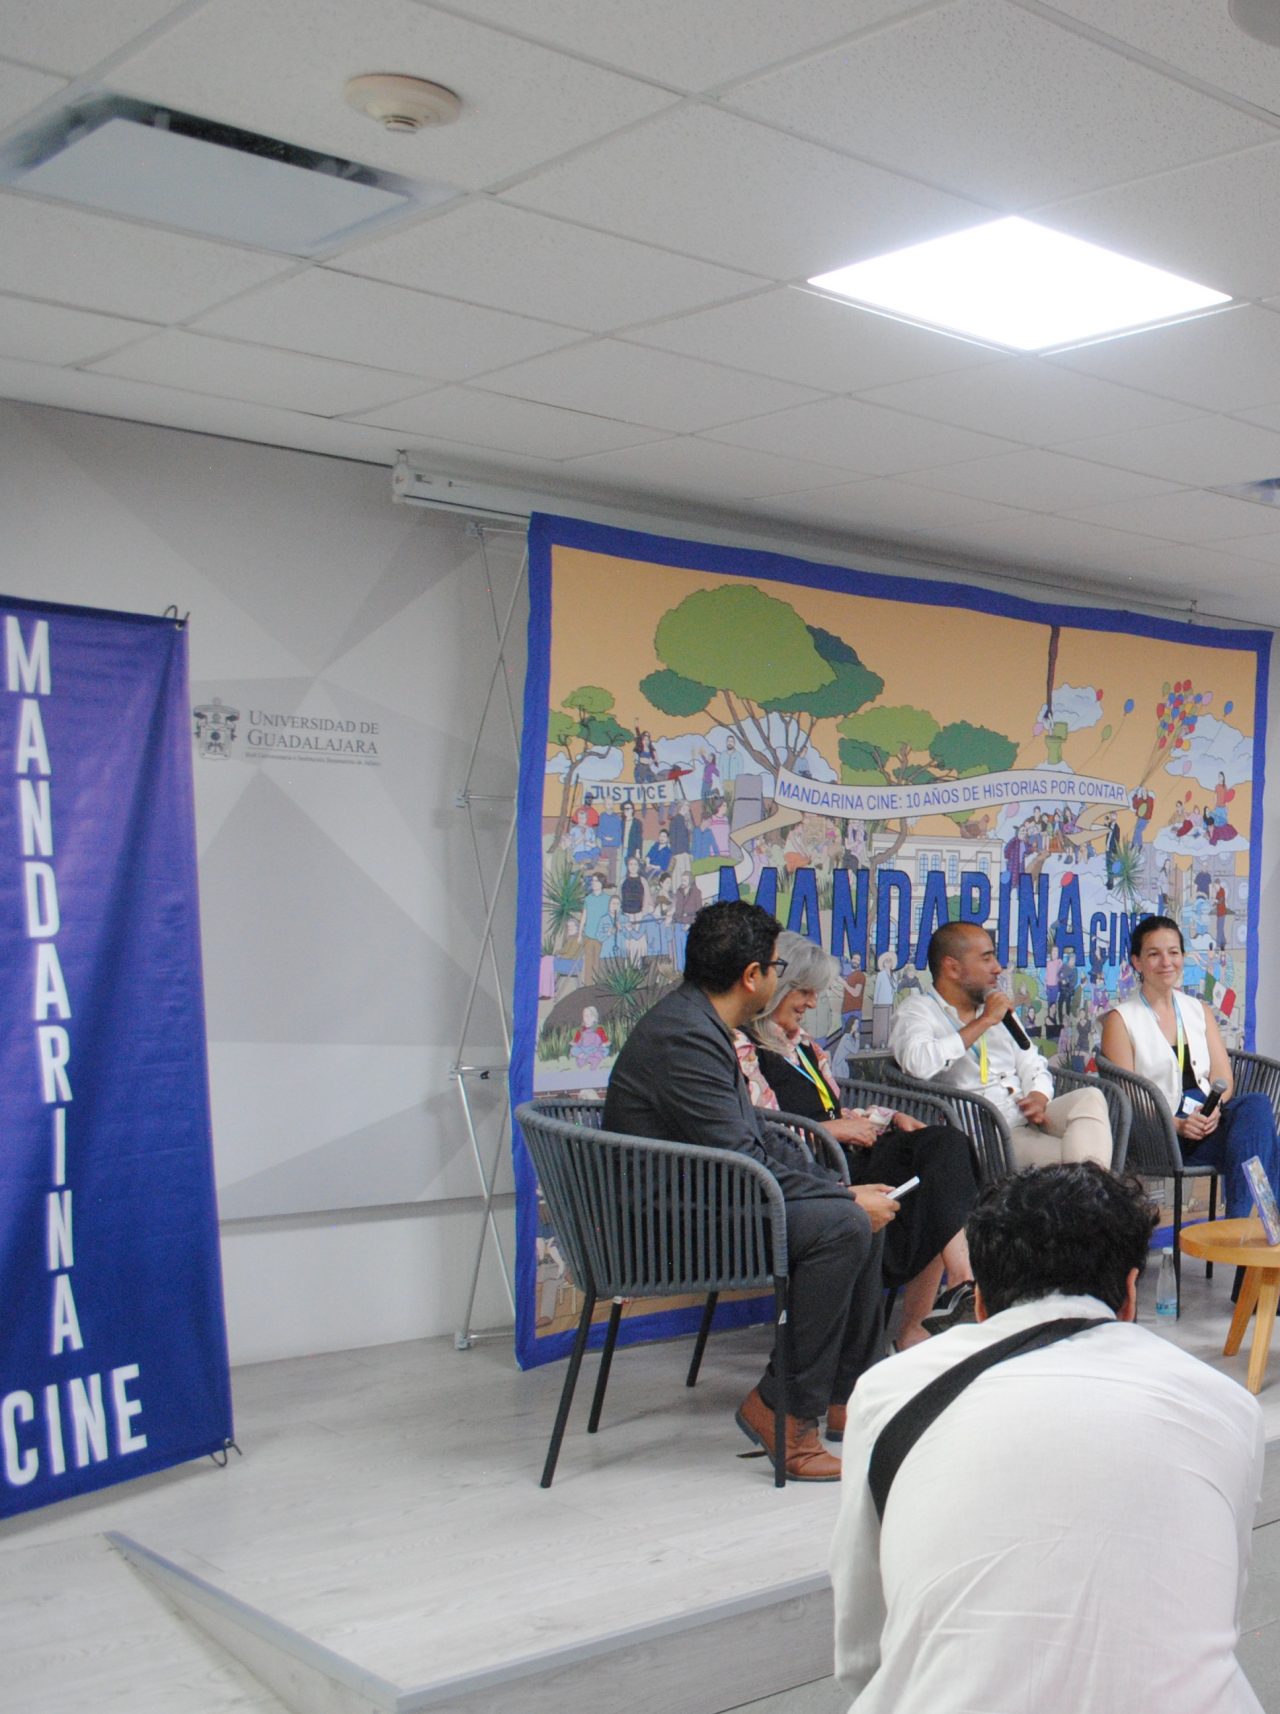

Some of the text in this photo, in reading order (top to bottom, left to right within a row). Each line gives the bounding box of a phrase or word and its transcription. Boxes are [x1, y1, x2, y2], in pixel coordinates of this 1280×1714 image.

[249, 710, 379, 735] UNIVERSIDAD DE
[247, 728, 378, 755] GUADALAJARA
[589, 784, 667, 801] JUSTICE
[779, 779, 1125, 810] MANDARINA CINE: 10 AÑOS DE HISTORIAS POR CONTAR
[1089, 911, 1156, 969] CIN
[6, 615, 84, 1356] MANDARINA
[2, 1363, 148, 1487] CINE
